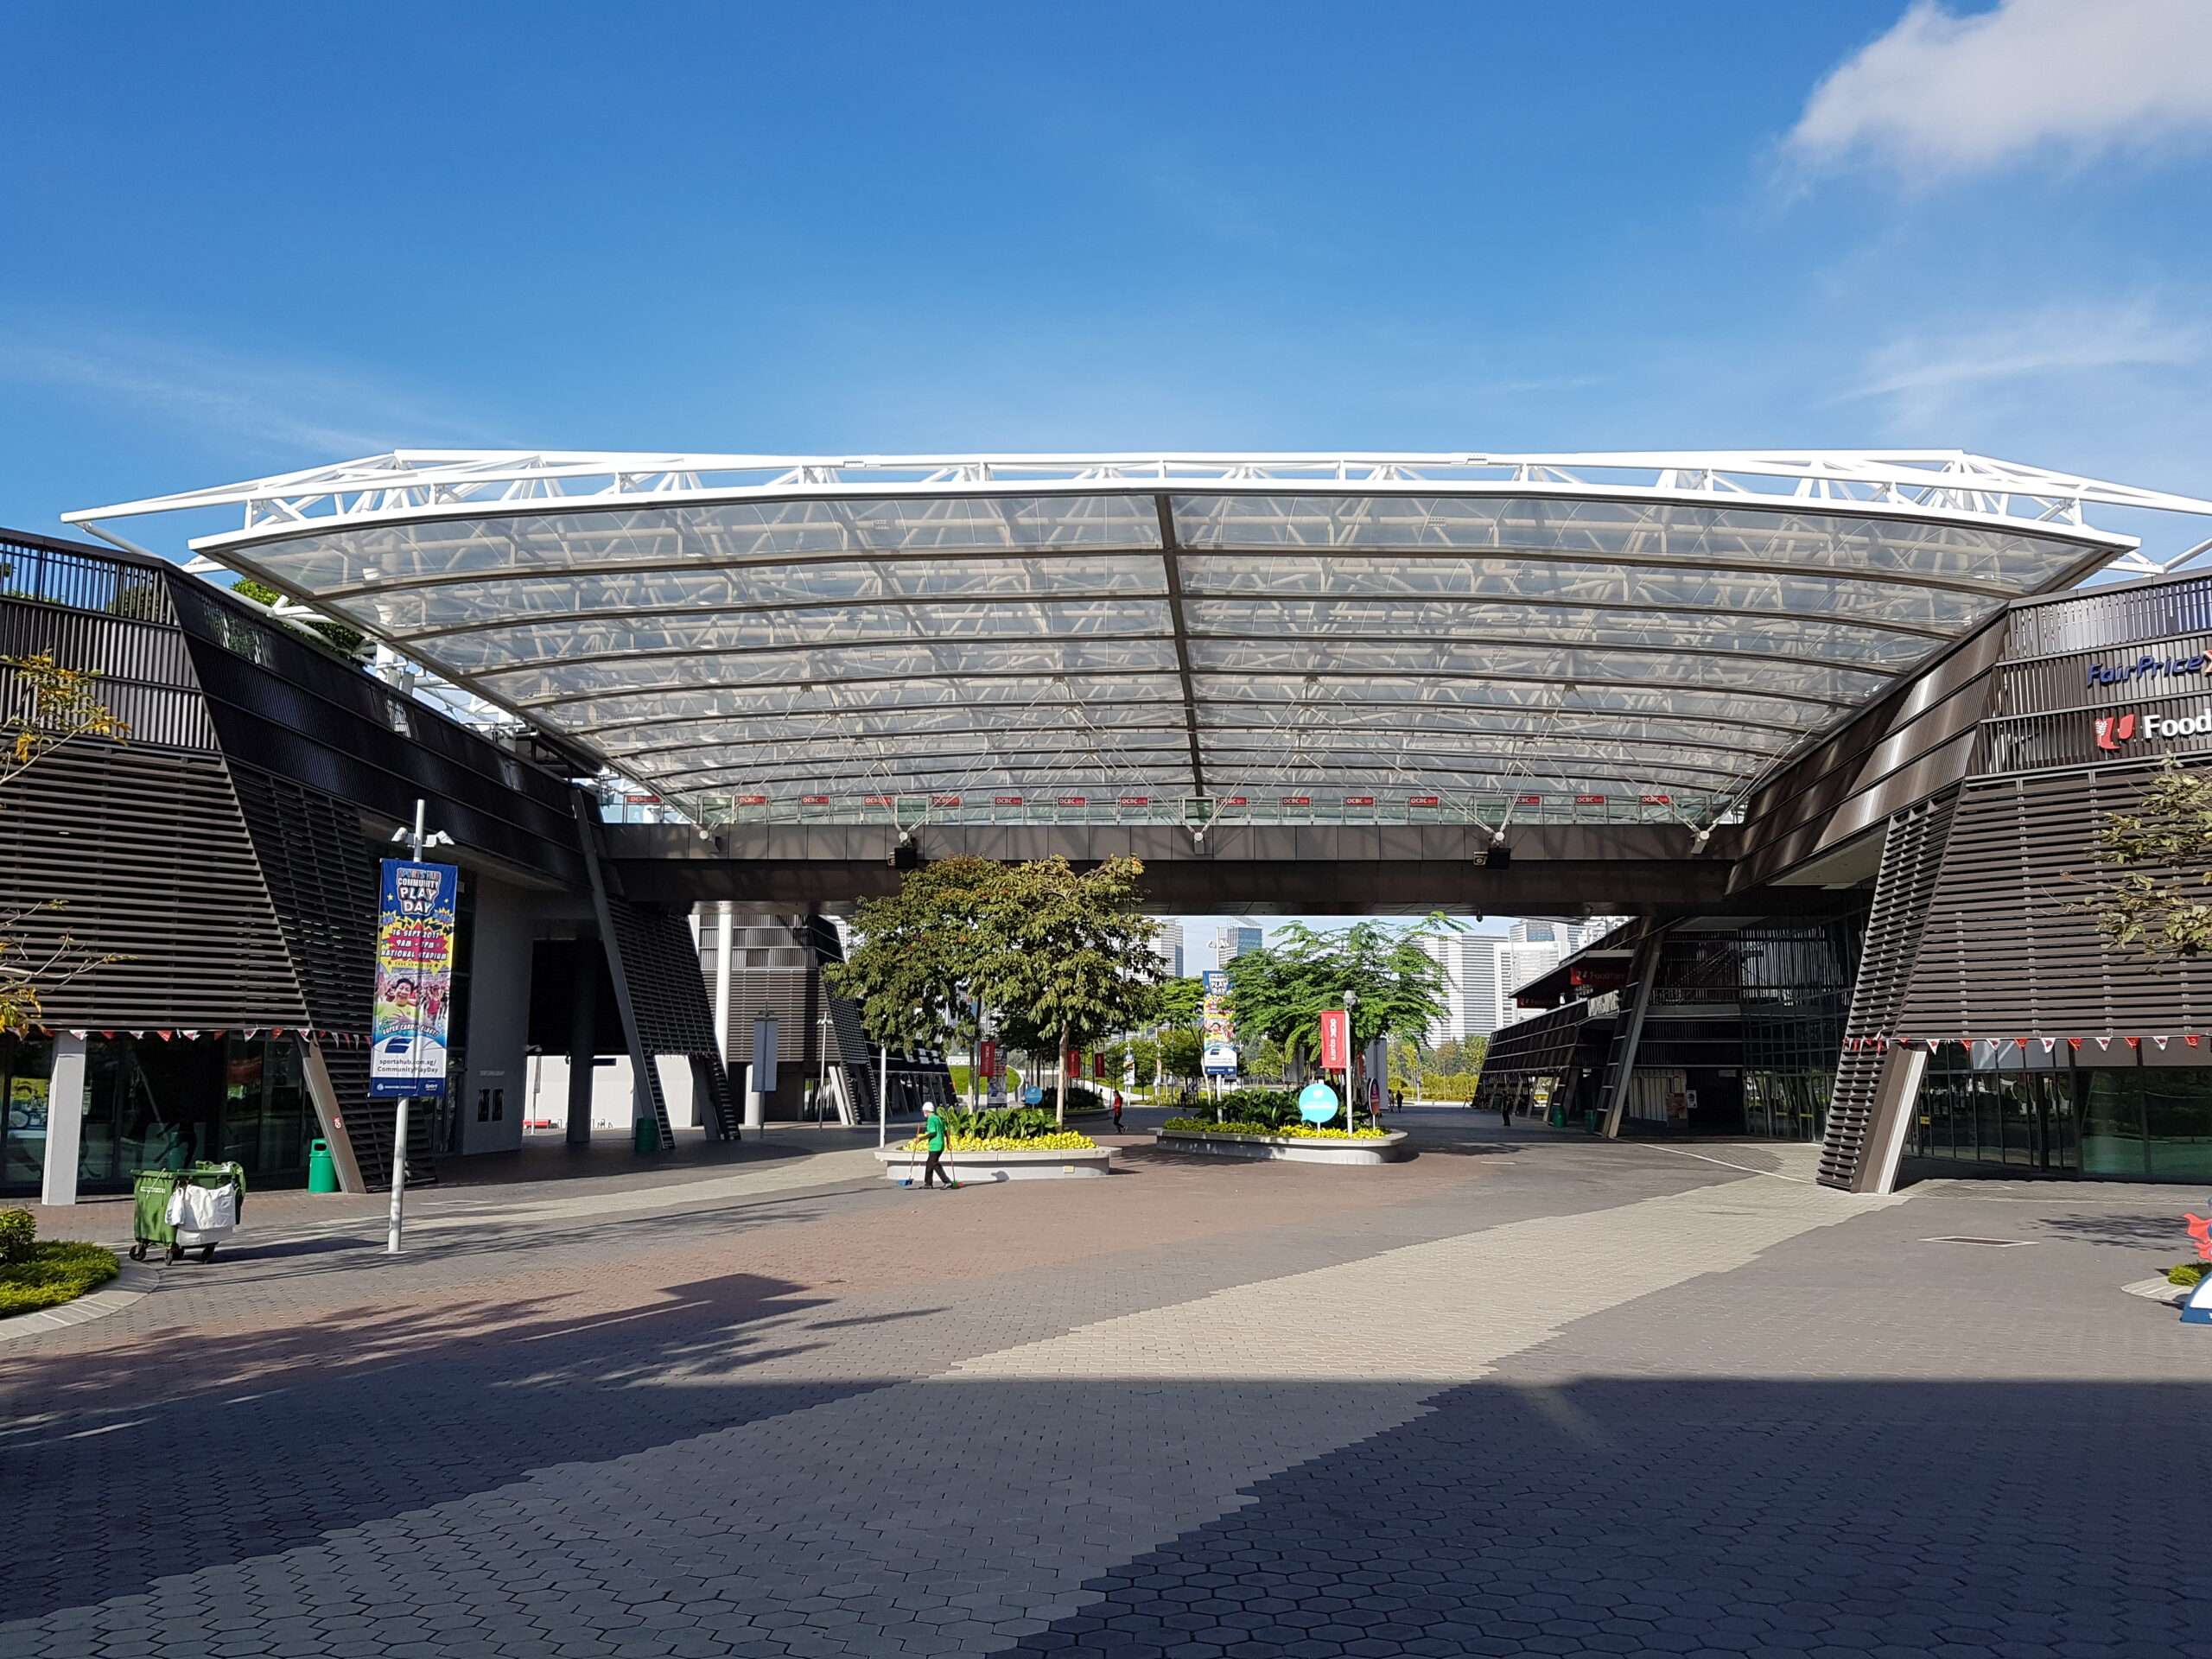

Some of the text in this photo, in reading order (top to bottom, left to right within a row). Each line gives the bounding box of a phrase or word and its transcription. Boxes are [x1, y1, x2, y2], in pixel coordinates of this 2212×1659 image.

[2087, 655, 2204, 688] FairPrice
[397, 878, 439, 888] COMMUNITY
[399, 887, 437, 901] PLAY
[404, 899, 433, 913] DAY
[380, 950, 416, 958] NATIONAL
